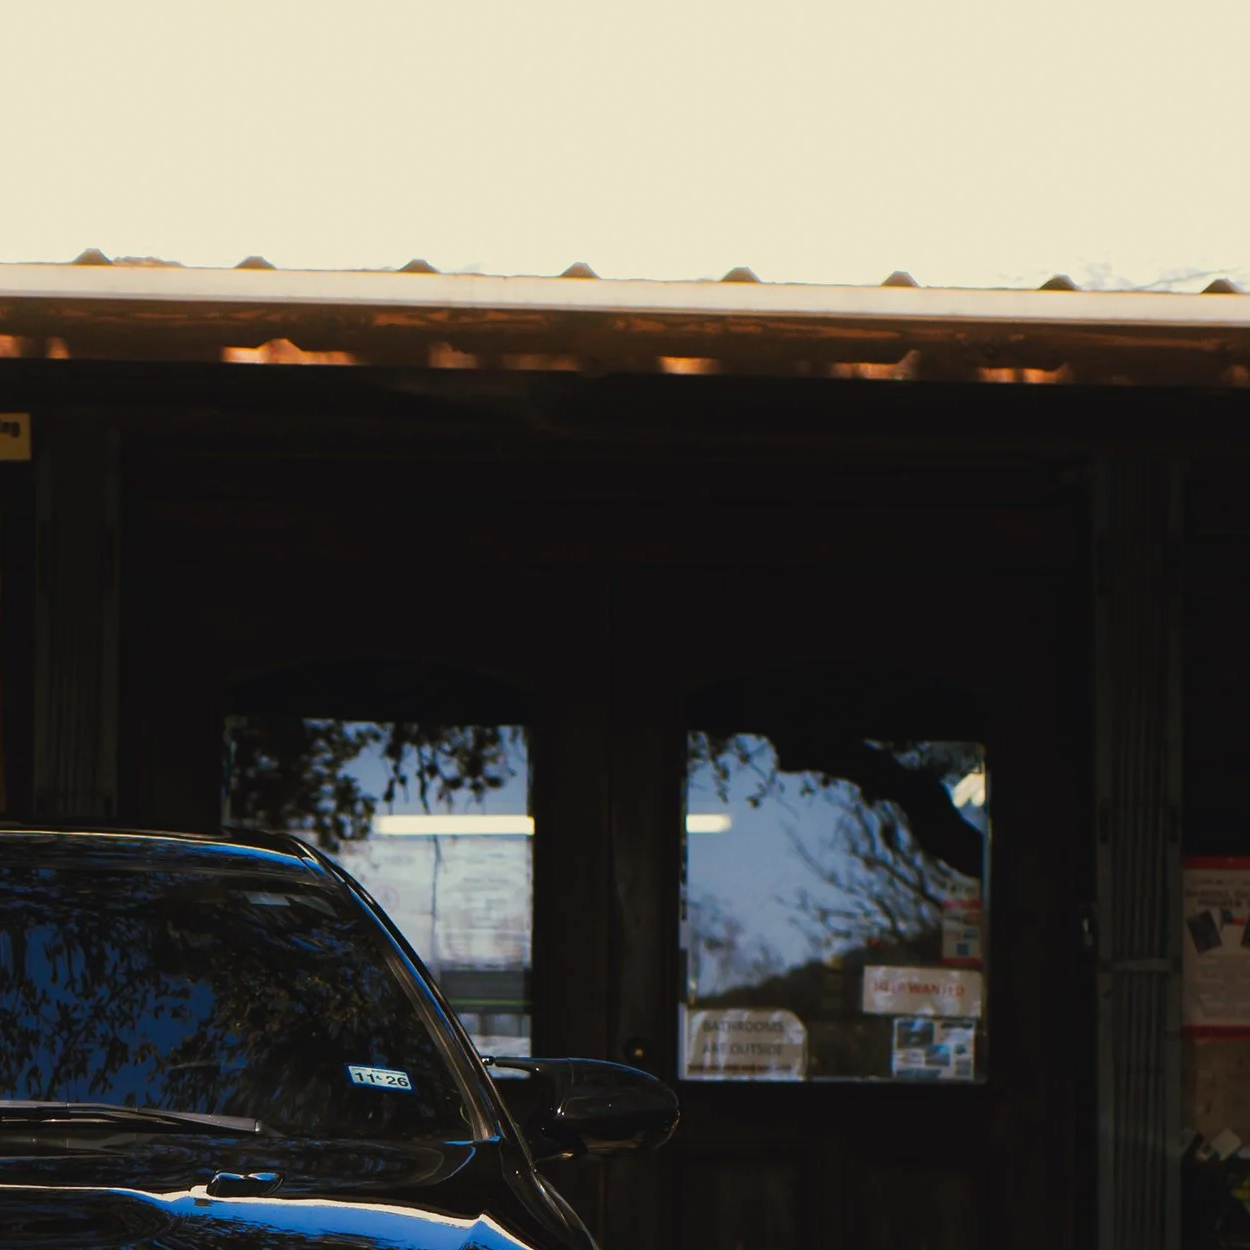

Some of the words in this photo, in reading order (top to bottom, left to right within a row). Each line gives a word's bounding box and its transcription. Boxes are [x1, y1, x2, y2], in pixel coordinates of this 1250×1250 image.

[907, 982, 966, 997] WANTED
[702, 1020, 785, 1033] BATHROOMS
[355, 1072, 375, 1083] 11
[386, 1075, 408, 1087] 26
